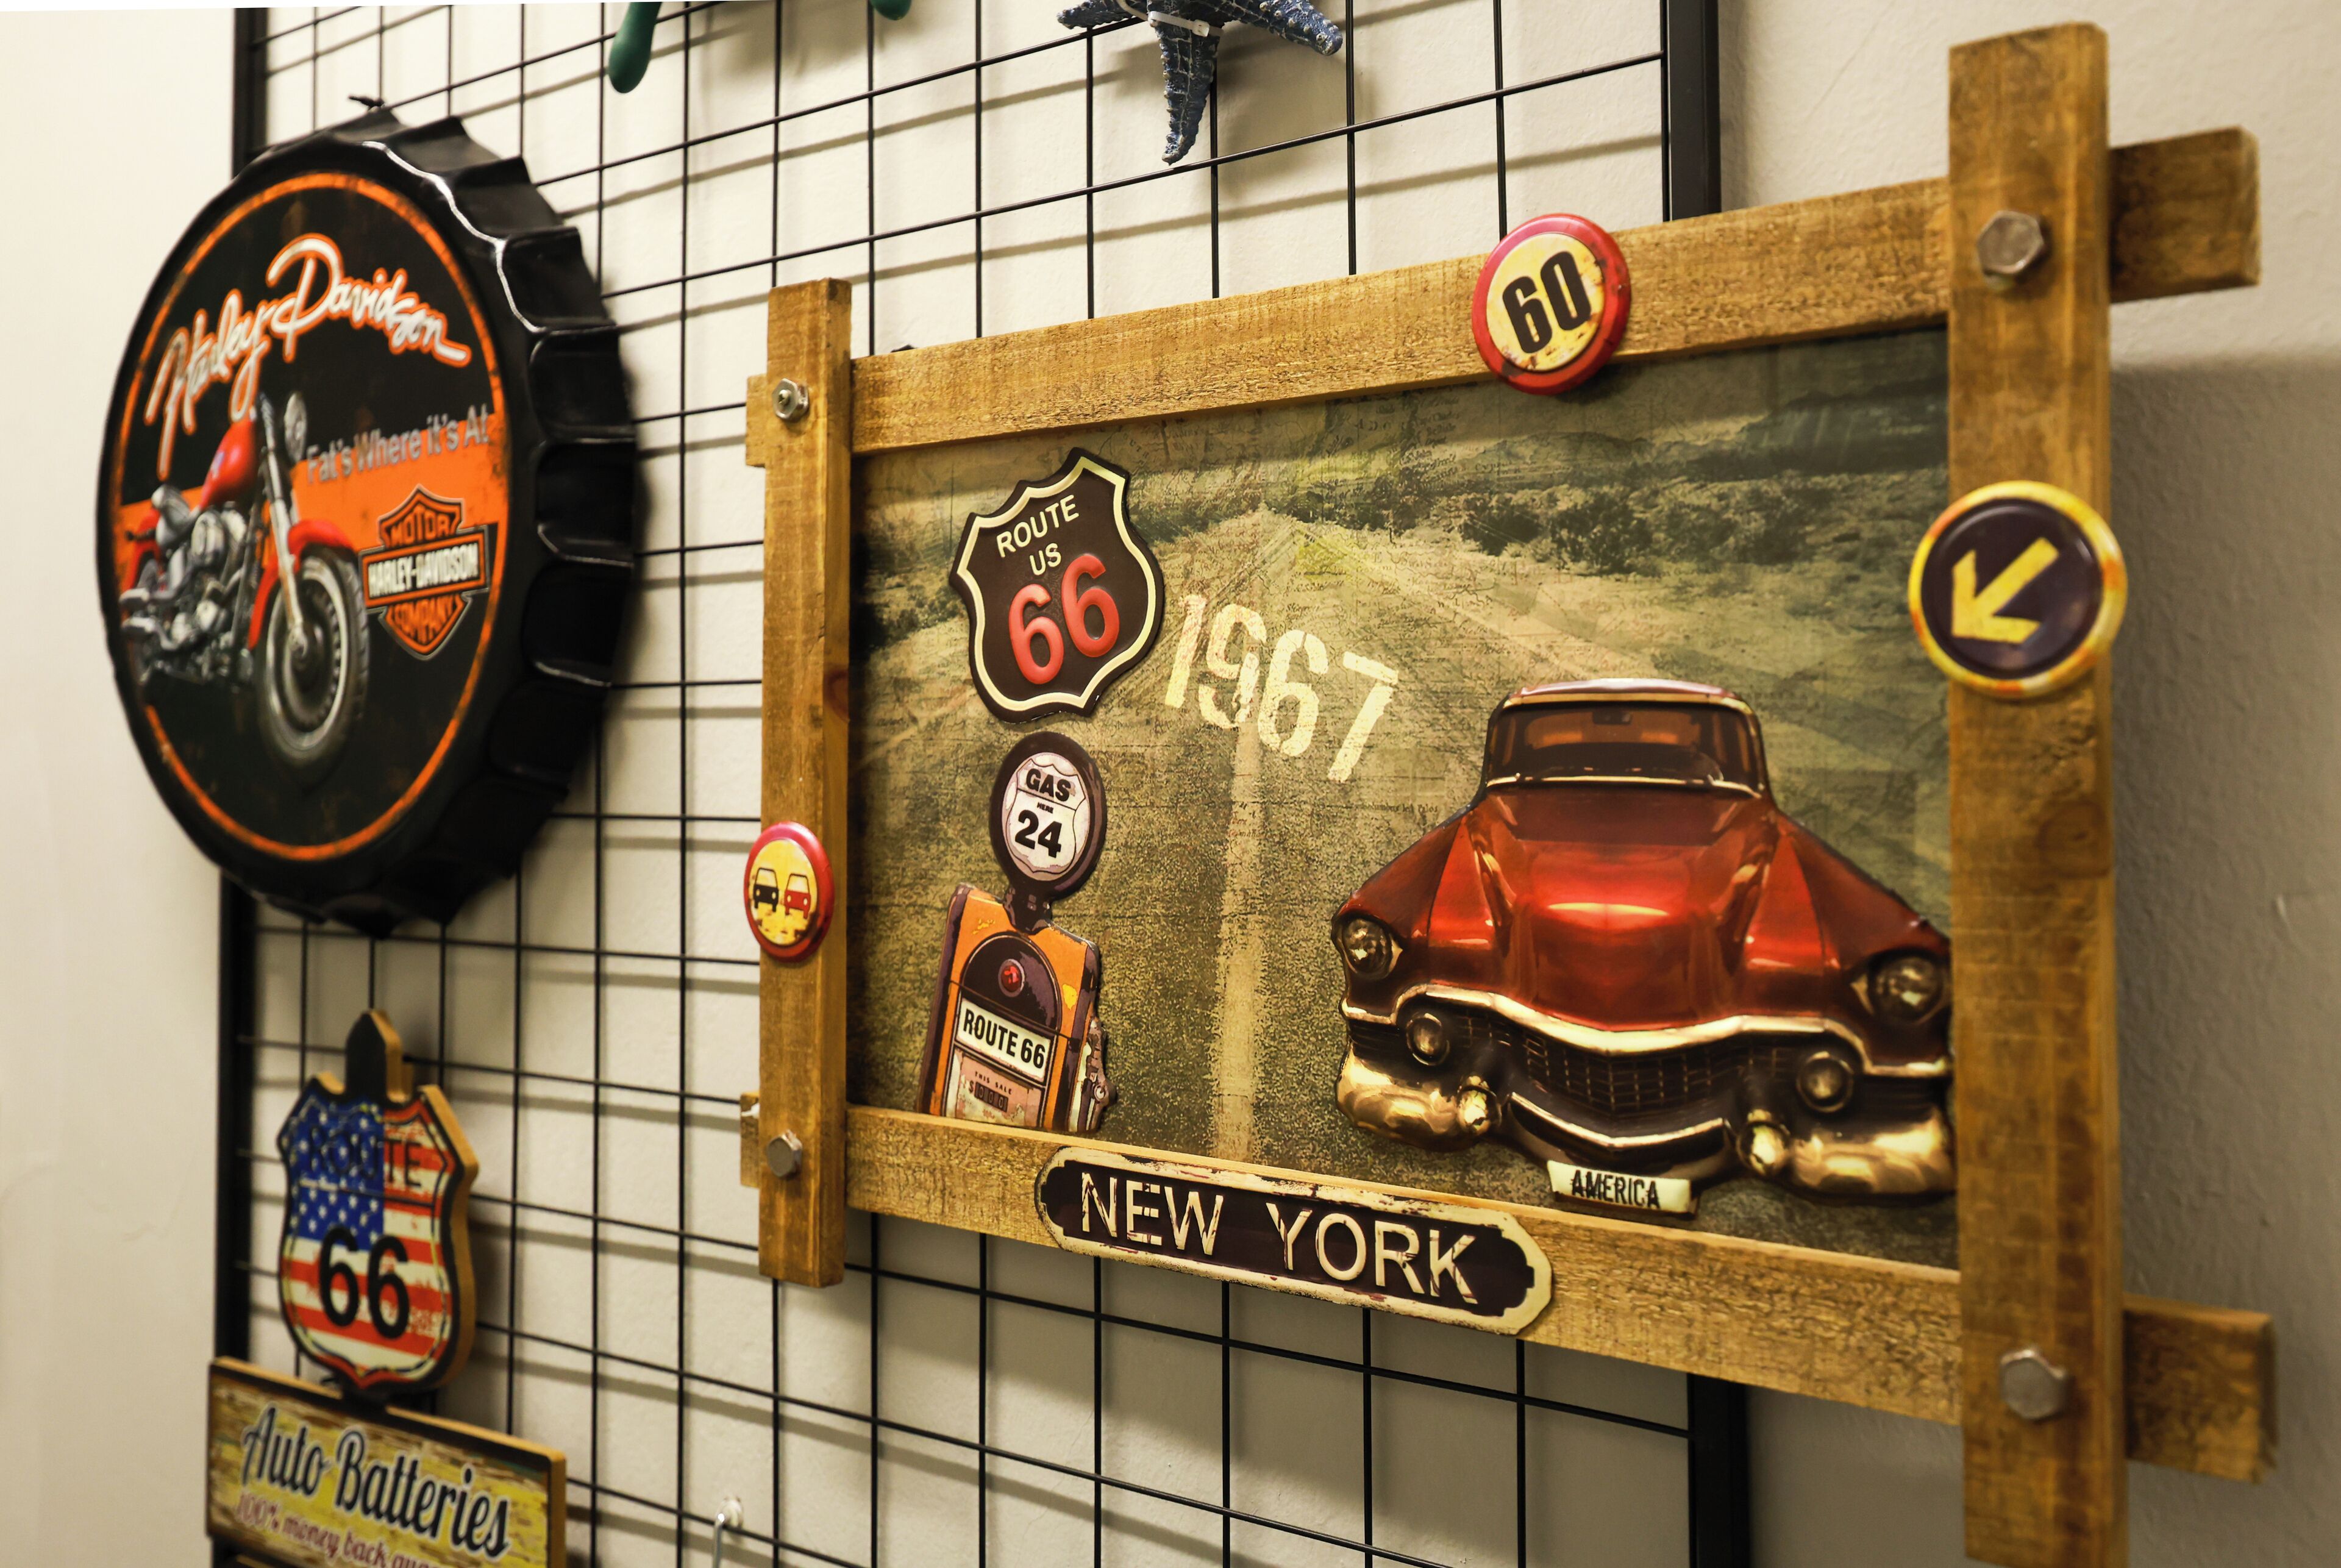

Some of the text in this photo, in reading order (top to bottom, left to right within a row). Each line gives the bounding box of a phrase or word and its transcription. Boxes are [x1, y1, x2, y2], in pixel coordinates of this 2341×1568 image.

[1502, 251, 1592, 354] 60
[144, 233, 471, 479] Harley Davidson
[306, 438, 353, 484] Fat's
[354, 429, 422, 473] Where
[390, 505, 451, 546] MOTOR
[996, 494, 1079, 557] ROUTE
[368, 543, 479, 598] HARLEY-DAVIDSON
[1029, 542, 1062, 576] US
[394, 595, 454, 644] COMPANY
[1008, 553, 1119, 684] 66
[1165, 594, 1399, 783] 1967
[1026, 768, 1071, 802] GAS
[1036, 802, 1054, 814] HERE
[1014, 810, 1062, 858] 24
[963, 1008, 1046, 1069] ROUTE 66
[975, 1071, 1013, 1095] THIS SALE
[1570, 1169, 1661, 1210] AMERICA
[1081, 1172, 1478, 1305] NEW YORK
[319, 1226, 410, 1339] 66
[243, 1406, 510, 1558] Auto Batteries
